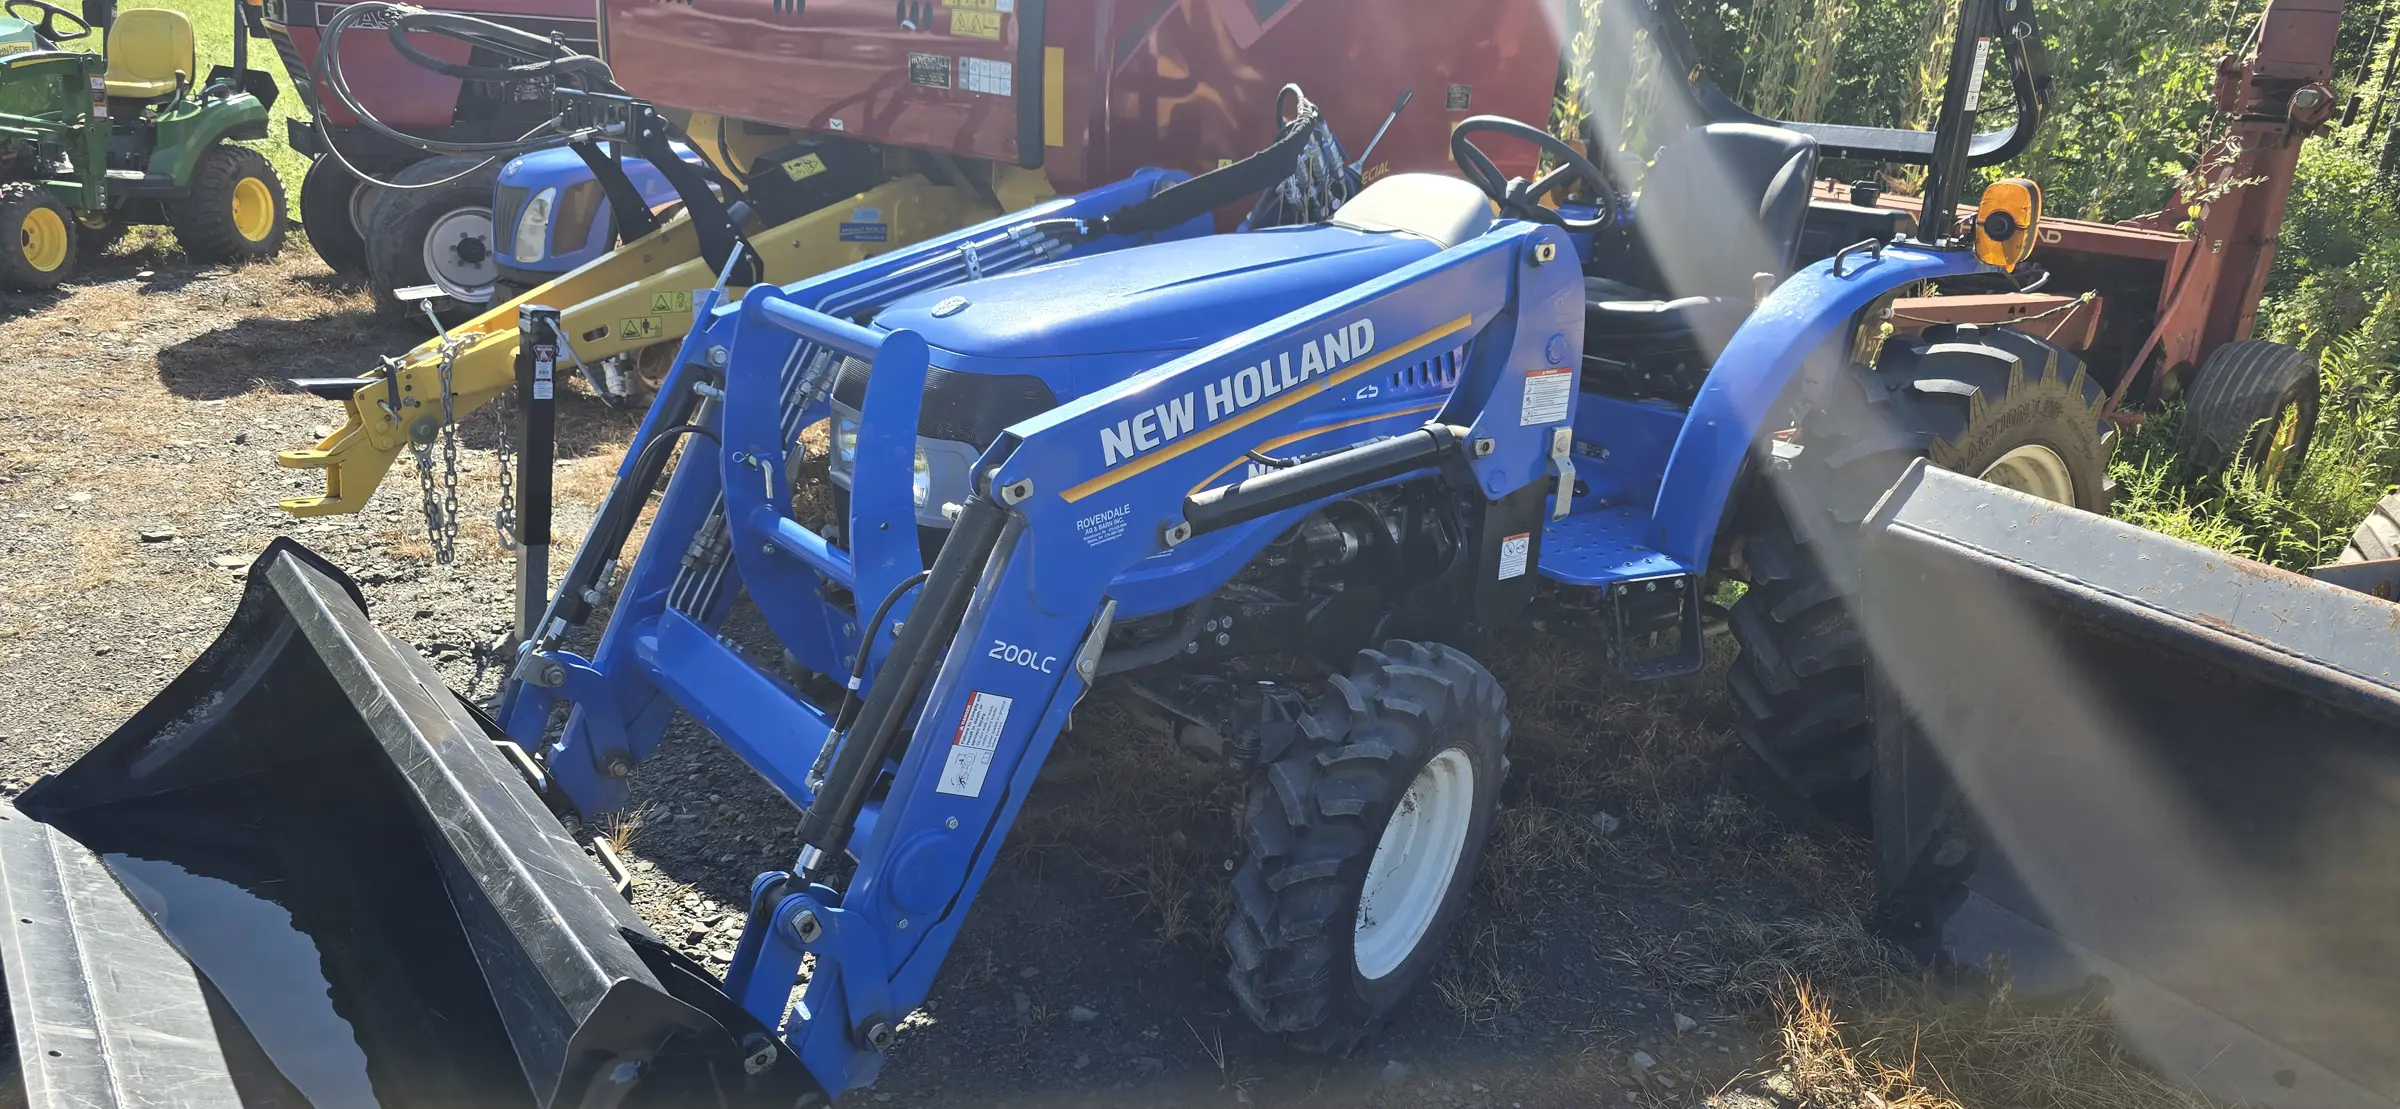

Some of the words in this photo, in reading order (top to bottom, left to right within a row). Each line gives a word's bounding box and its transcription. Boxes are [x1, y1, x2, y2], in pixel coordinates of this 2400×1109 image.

[1100, 392, 1196, 467] NEW
[1204, 318, 1375, 423] HOLLAND
[1076, 503, 1131, 531] ROVENDALE
[1085, 527, 1093, 536] AG
[1098, 520, 1113, 531] BARN
[988, 639, 1057, 674] 200LC
